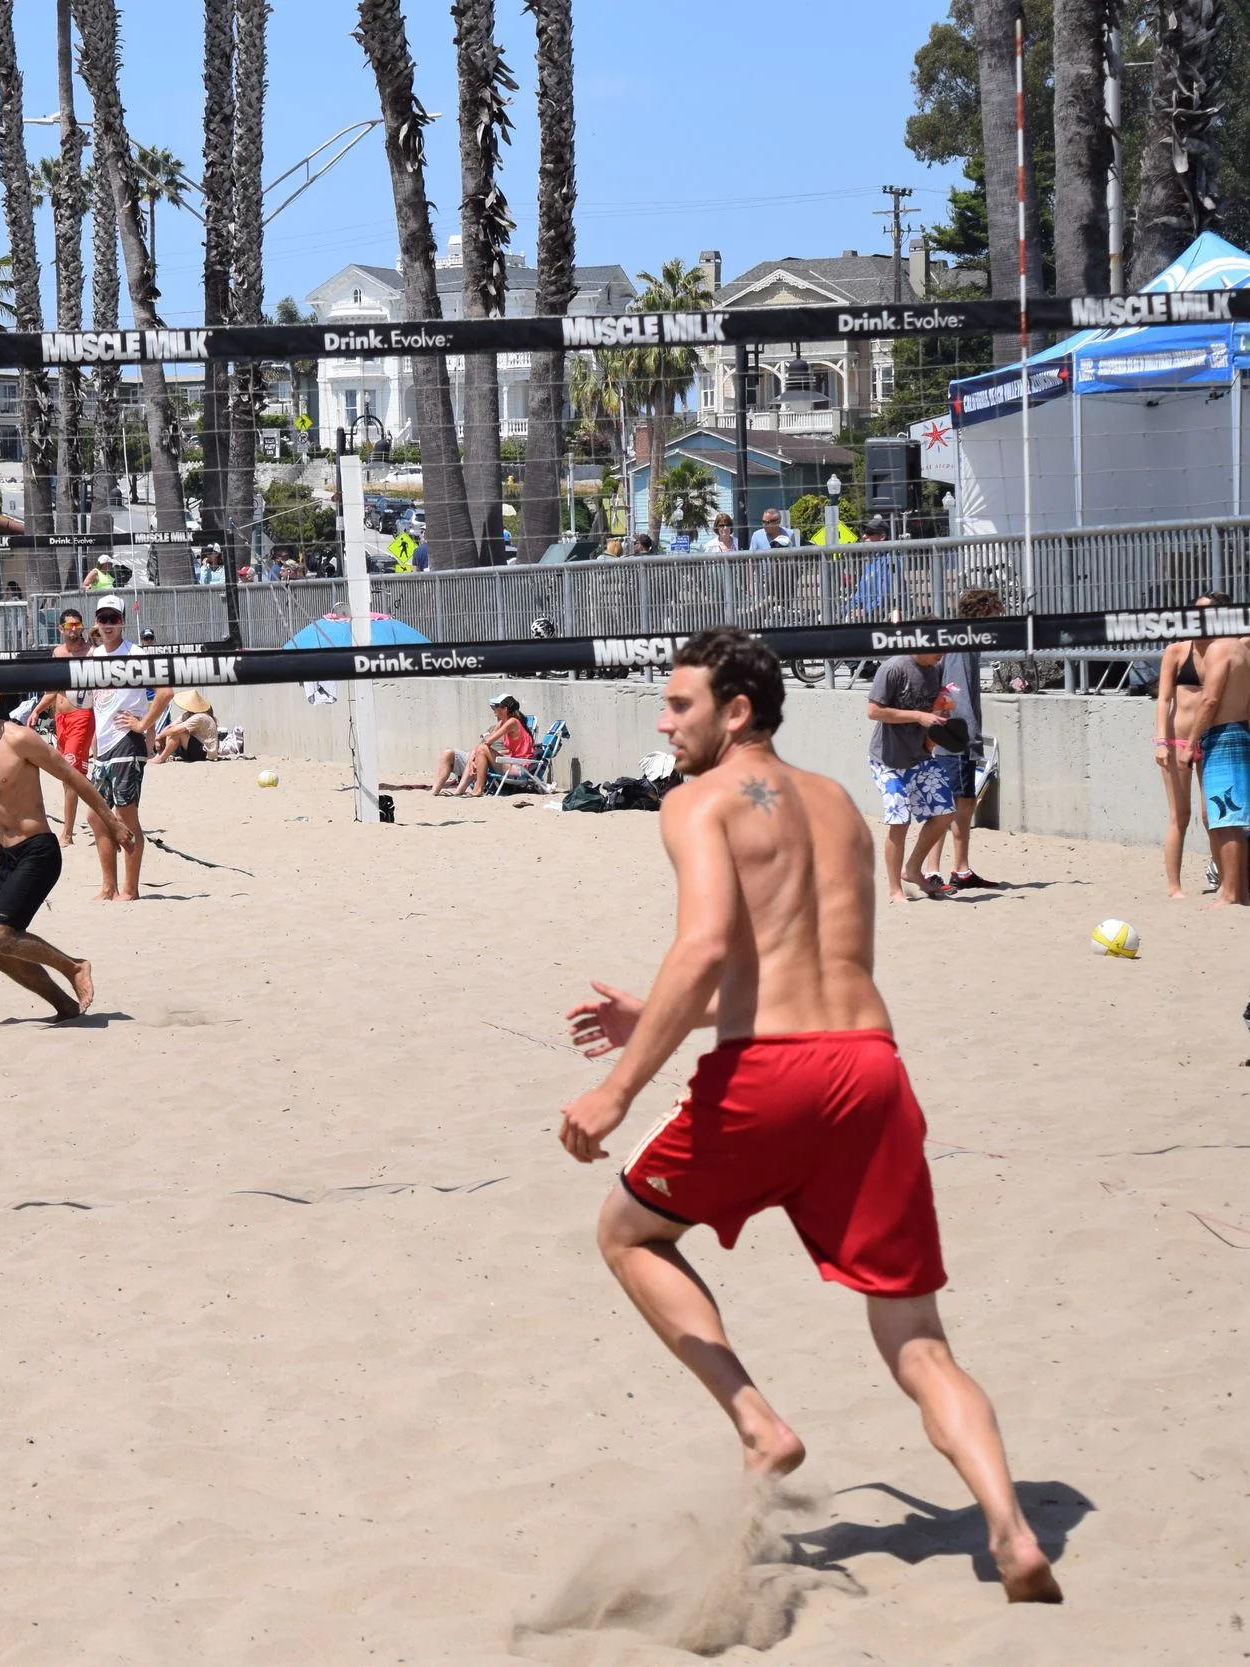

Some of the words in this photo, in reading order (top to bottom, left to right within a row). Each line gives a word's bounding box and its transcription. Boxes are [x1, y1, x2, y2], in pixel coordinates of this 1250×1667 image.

[1071, 297, 1166, 326] MUSCLE
[1170, 293, 1232, 319] MILK
[562, 317, 659, 346] MUSCLE
[663, 314, 726, 342] MILK
[41, 333, 140, 363] MUSCLE
[146, 331, 209, 359] MILK
[135, 533, 170, 543] MUSCLE
[171, 532, 194, 542] MILK
[1106, 612, 1201, 642] MUSCLE
[69, 660, 169, 688] MUSCLE
[174, 657, 238, 685] MILK
